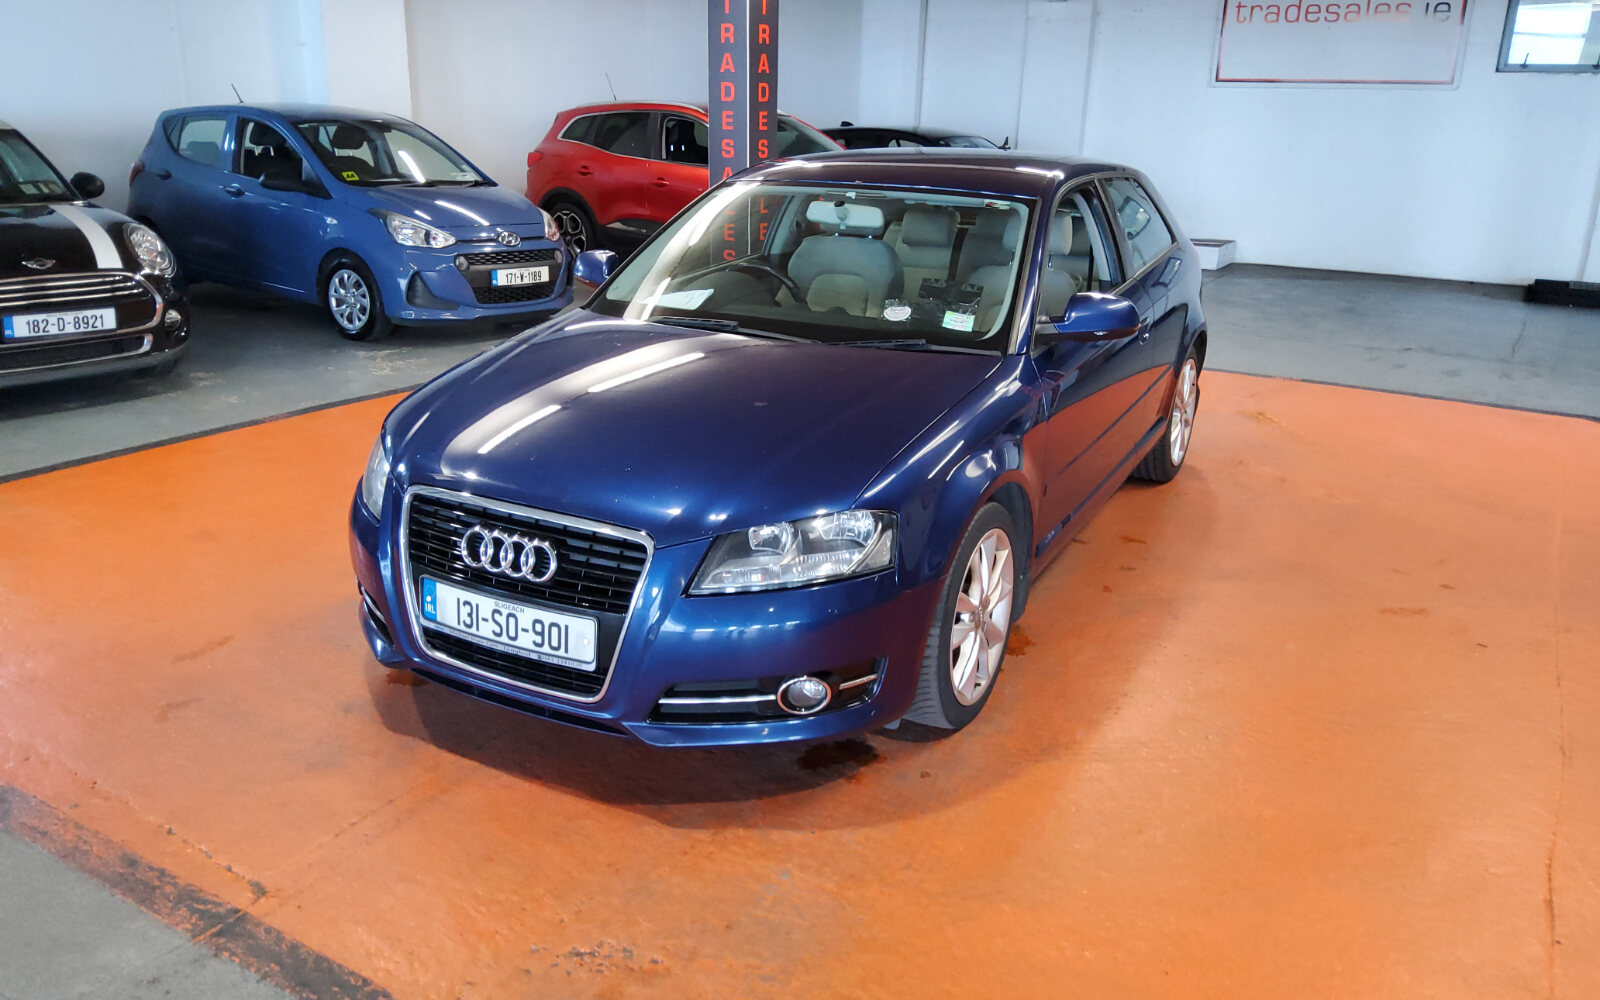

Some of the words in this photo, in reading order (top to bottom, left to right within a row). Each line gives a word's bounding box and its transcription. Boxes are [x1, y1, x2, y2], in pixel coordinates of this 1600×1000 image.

[26, 313, 104, 334] 182-D-8921
[425, 603, 436, 614] IRL
[494, 601, 525, 614] SLIGEACH
[456, 597, 569, 654] 131-SO-901
